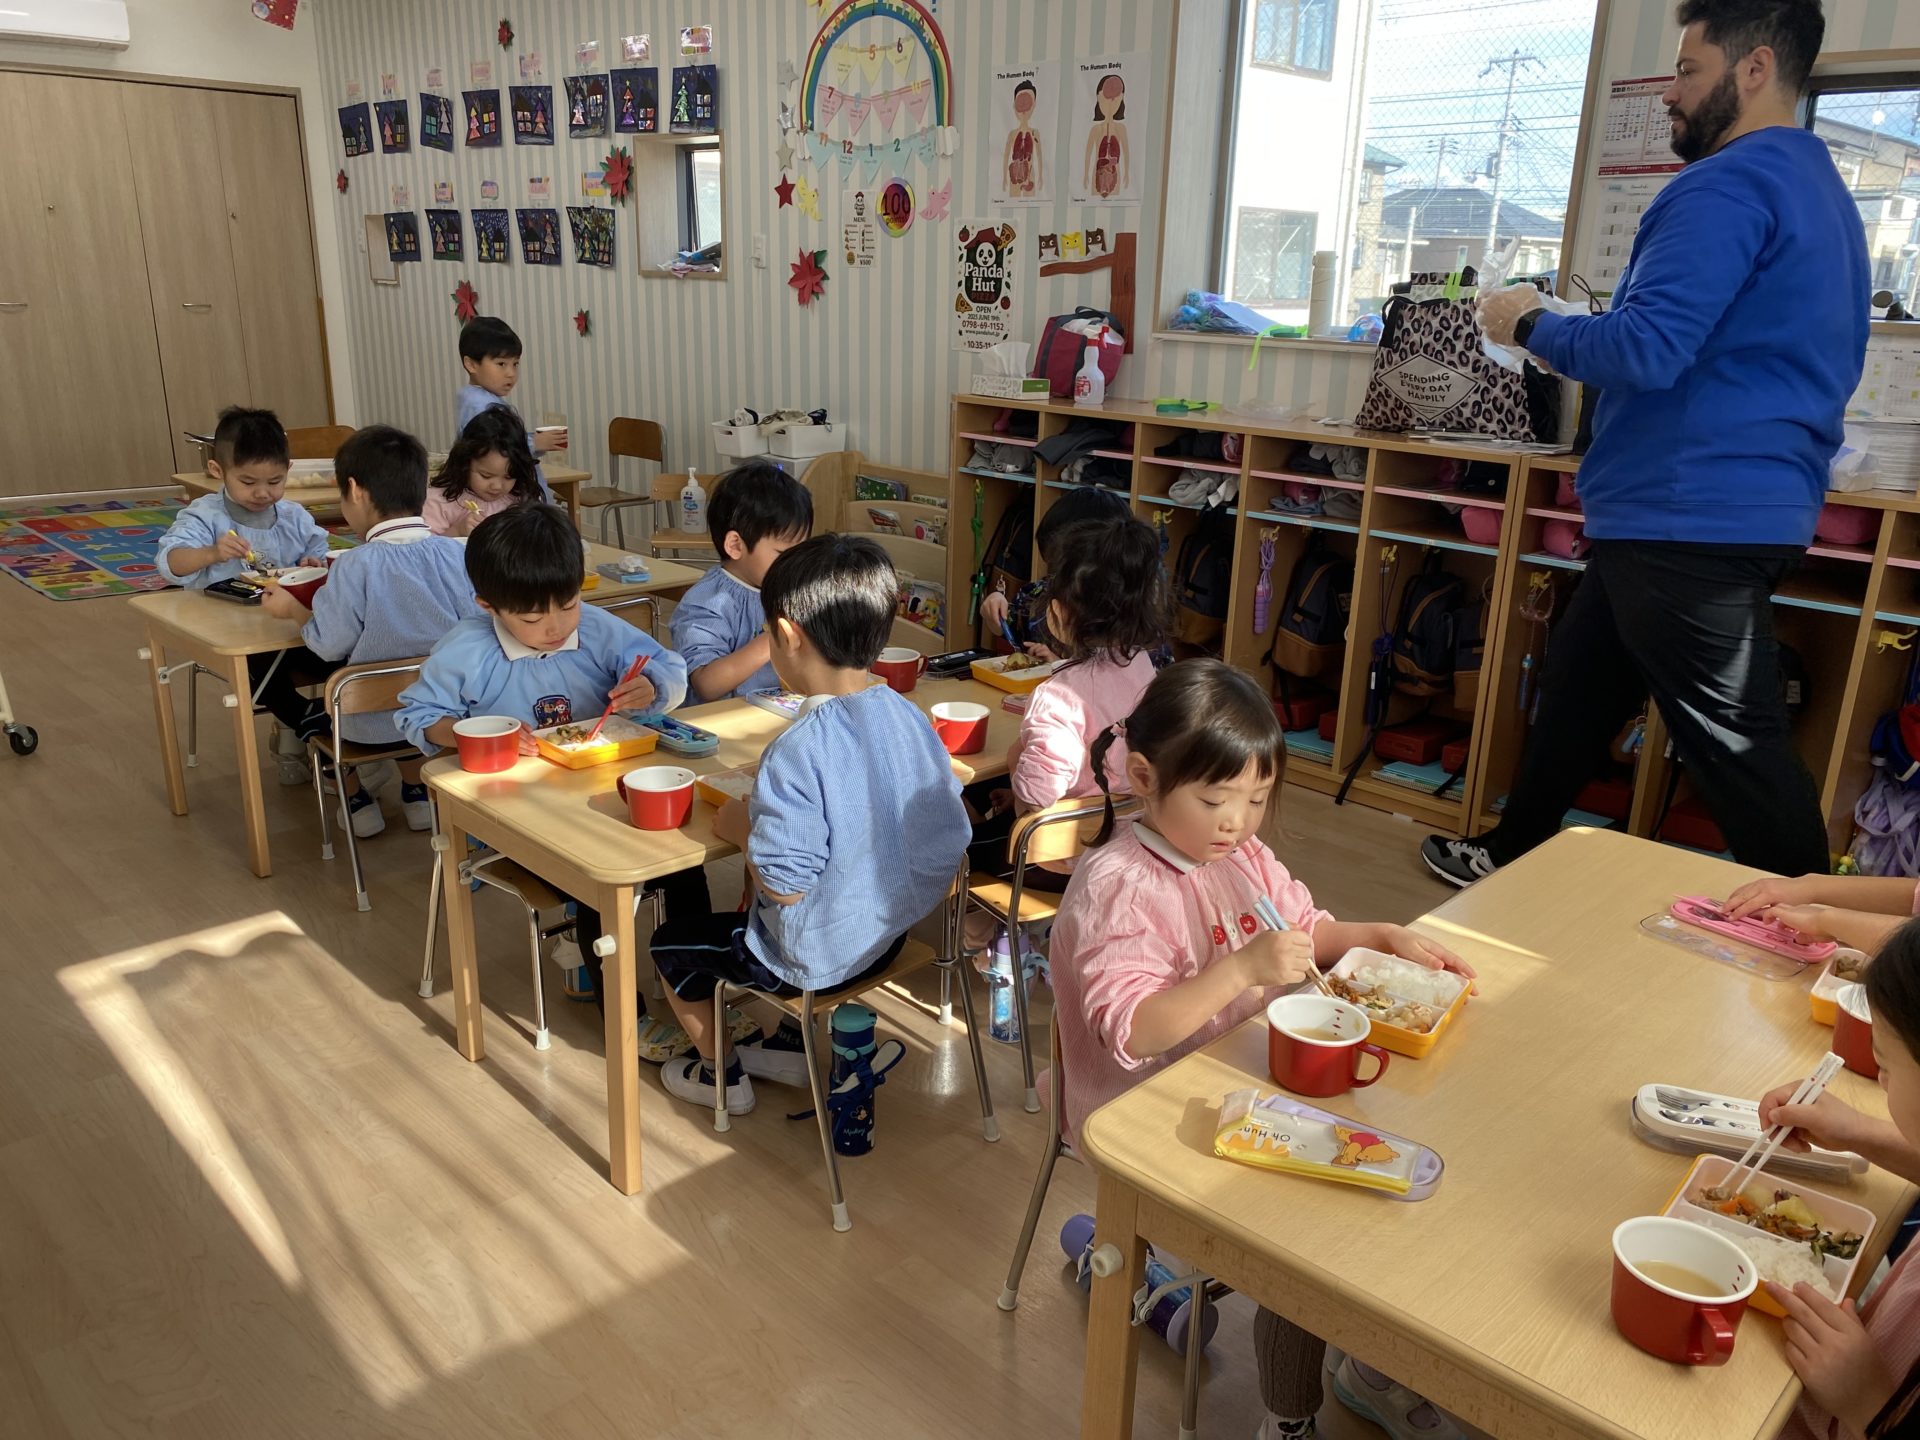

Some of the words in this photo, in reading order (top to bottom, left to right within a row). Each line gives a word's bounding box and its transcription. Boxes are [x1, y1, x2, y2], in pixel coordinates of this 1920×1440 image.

[869, 44, 876, 60] 5
[896, 37, 903, 53] 6
[828, 86, 835, 99] 7
[842, 140, 853, 155] 12
[868, 143, 873, 157] 1
[893, 138, 901, 153] 2
[882, 192, 912, 216] 100
[964, 262, 1004, 279] Panda
[972, 277, 996, 292] Hut
[975, 305, 992, 314] OPEN
[961, 320, 1004, 331] 0798-69-1152
[1398, 371, 1450, 384] SPENDING
[1400, 379, 1426, 393] EVERY
[1429, 383, 1452, 393] DAY
[1407, 389, 1446, 402] HAPPILY
[1237, 1127, 1268, 1138] Hun
[1272, 1132, 1291, 1142] Oh
